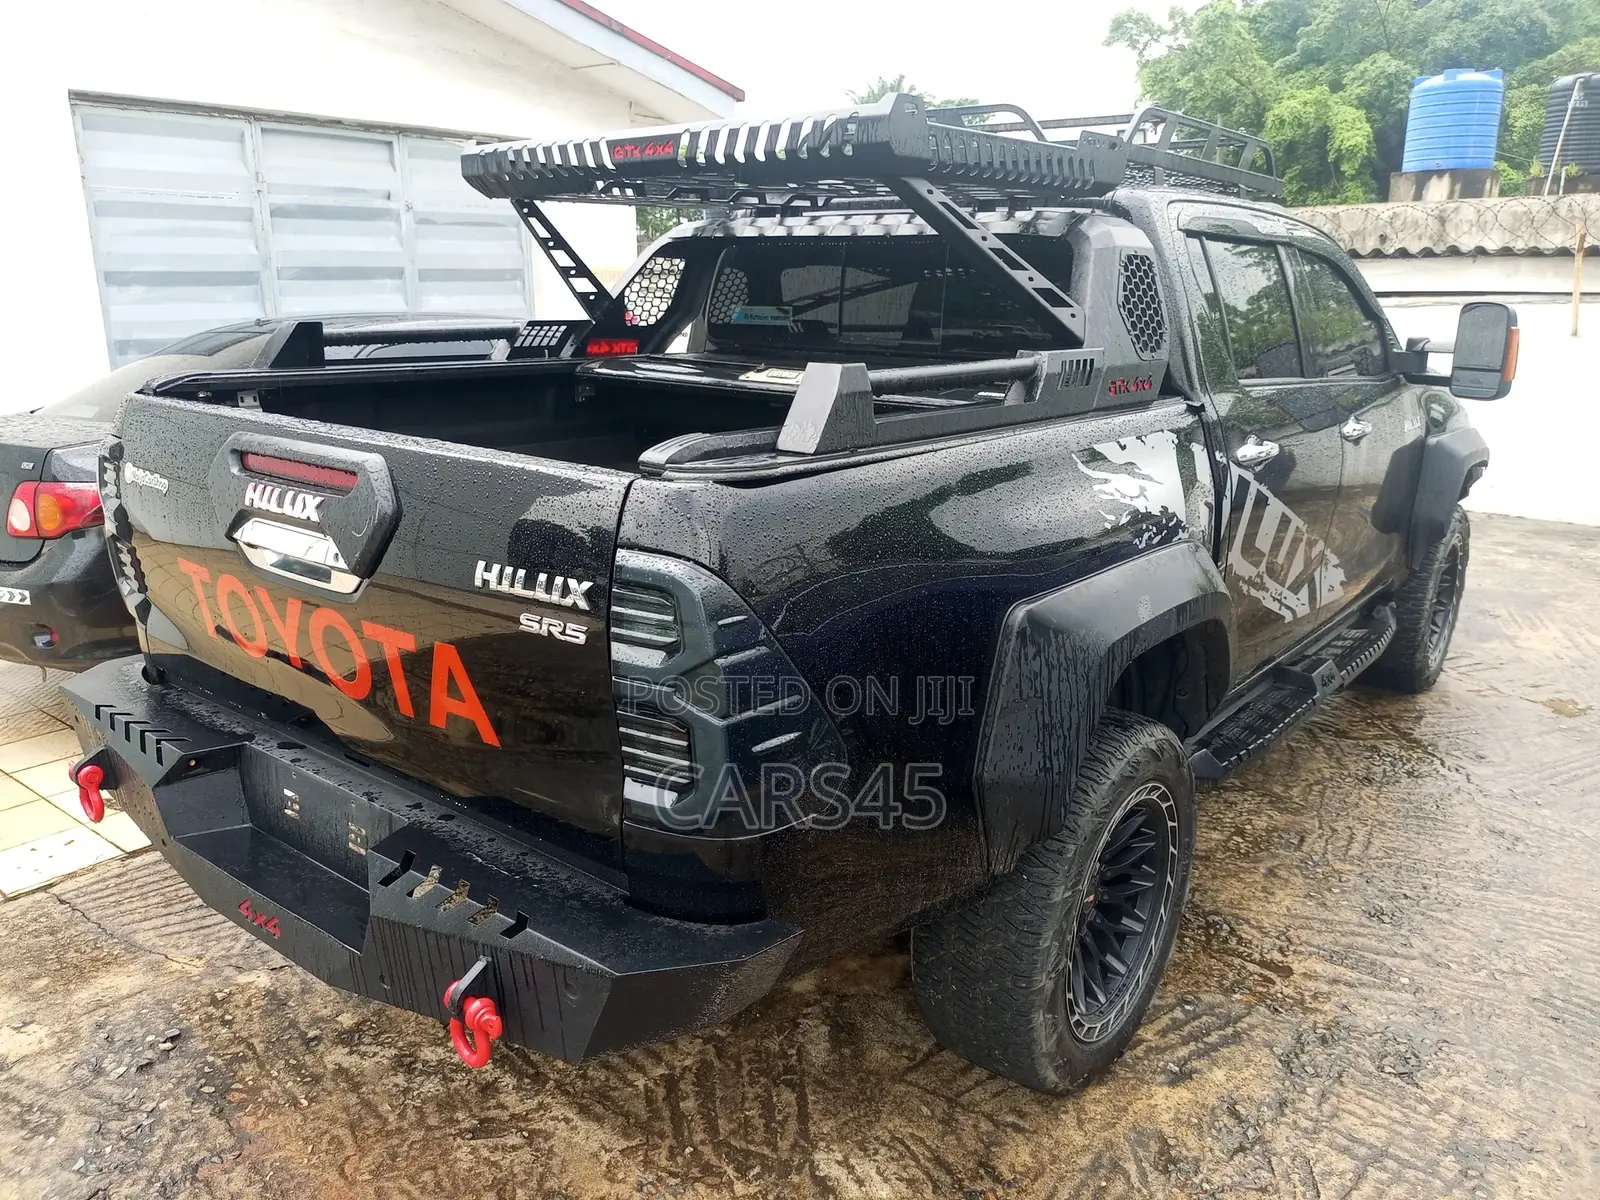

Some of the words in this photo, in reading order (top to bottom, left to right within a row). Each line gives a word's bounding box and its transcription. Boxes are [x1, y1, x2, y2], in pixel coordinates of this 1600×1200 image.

[643, 140, 675, 155] 4x4
[1131, 374, 1153, 391] 4x4
[244, 482, 325, 523] HILUX
[474, 560, 594, 611] HILUX
[519, 612, 589, 645] SR5
[177, 556, 501, 748] TOYOTA
[238, 899, 281, 939] 4x4
